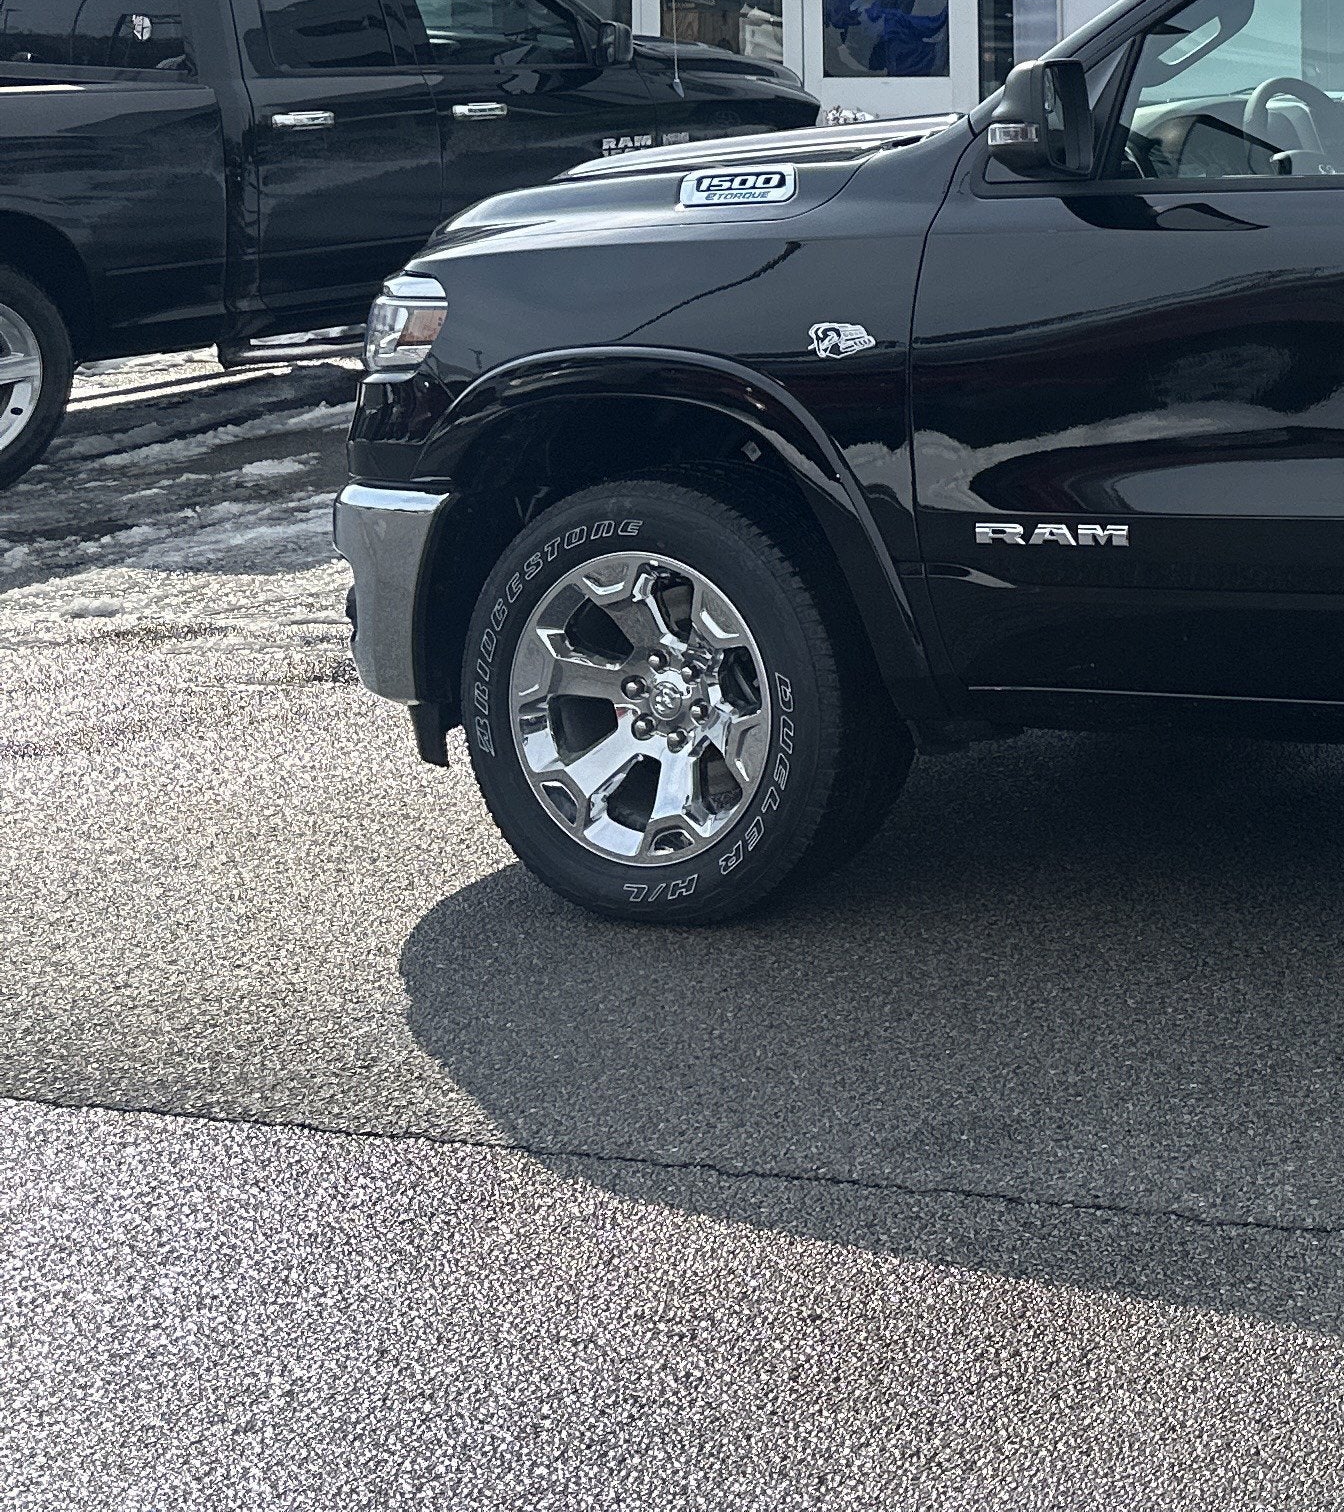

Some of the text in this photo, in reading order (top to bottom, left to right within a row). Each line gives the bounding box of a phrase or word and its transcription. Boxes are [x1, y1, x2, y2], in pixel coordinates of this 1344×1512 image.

[602, 135, 652, 150] RAM
[699, 173, 782, 191] 1500
[975, 522, 1129, 547] RAM
[476, 519, 644, 758] BRIDGESTONE
[622, 672, 795, 903] DUELER H/L
